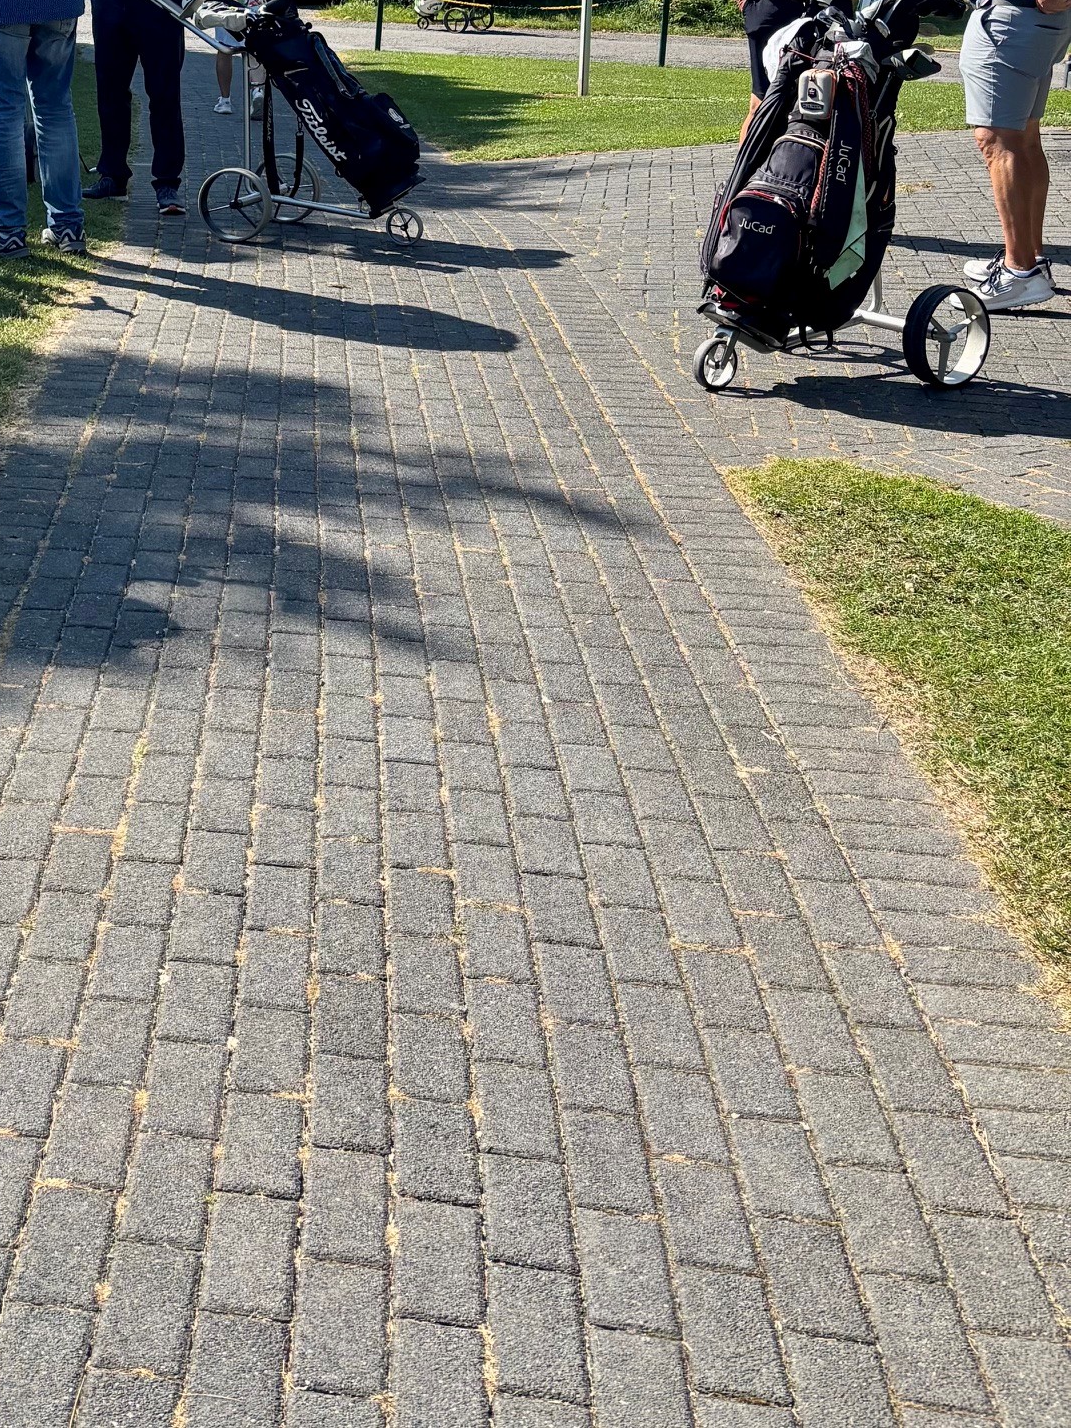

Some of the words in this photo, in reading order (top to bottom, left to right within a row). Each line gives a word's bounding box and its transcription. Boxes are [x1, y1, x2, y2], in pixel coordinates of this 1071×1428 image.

[295, 98, 348, 162] Titleist
[835, 140, 853, 183] JuCad
[738, 218, 774, 235] JuCad
